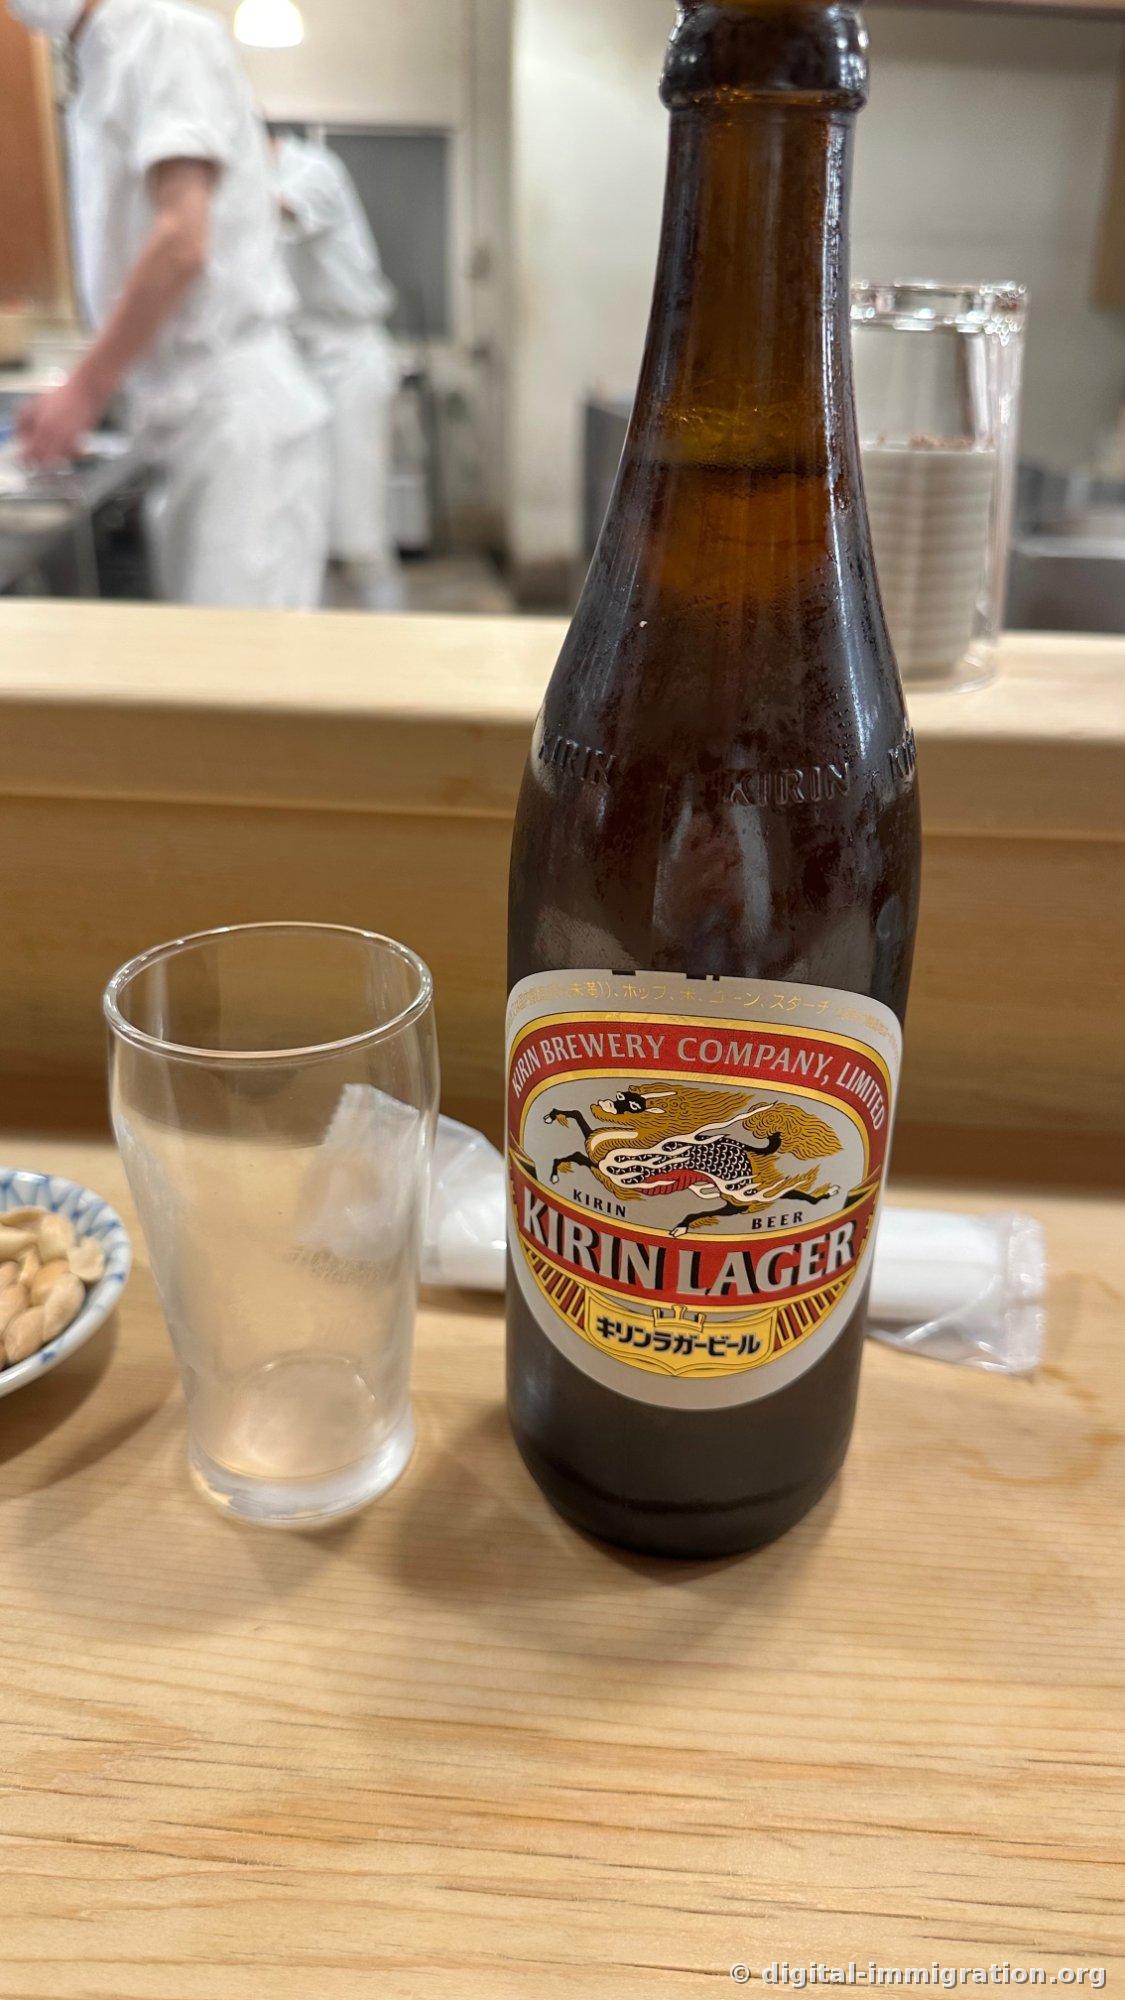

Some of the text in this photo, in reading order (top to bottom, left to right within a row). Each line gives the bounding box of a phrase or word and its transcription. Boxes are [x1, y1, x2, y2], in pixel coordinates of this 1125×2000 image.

[725, 762, 851, 807] KIRIN
[511, 1033, 886, 1132] KIRIN BREWERY COMPANY, LIMITED
[572, 1189, 804, 1230] KIRIN BEER
[523, 1187, 857, 1297] KIRIN LAGER
[595, 1314, 761, 1357] キリンラガービール
